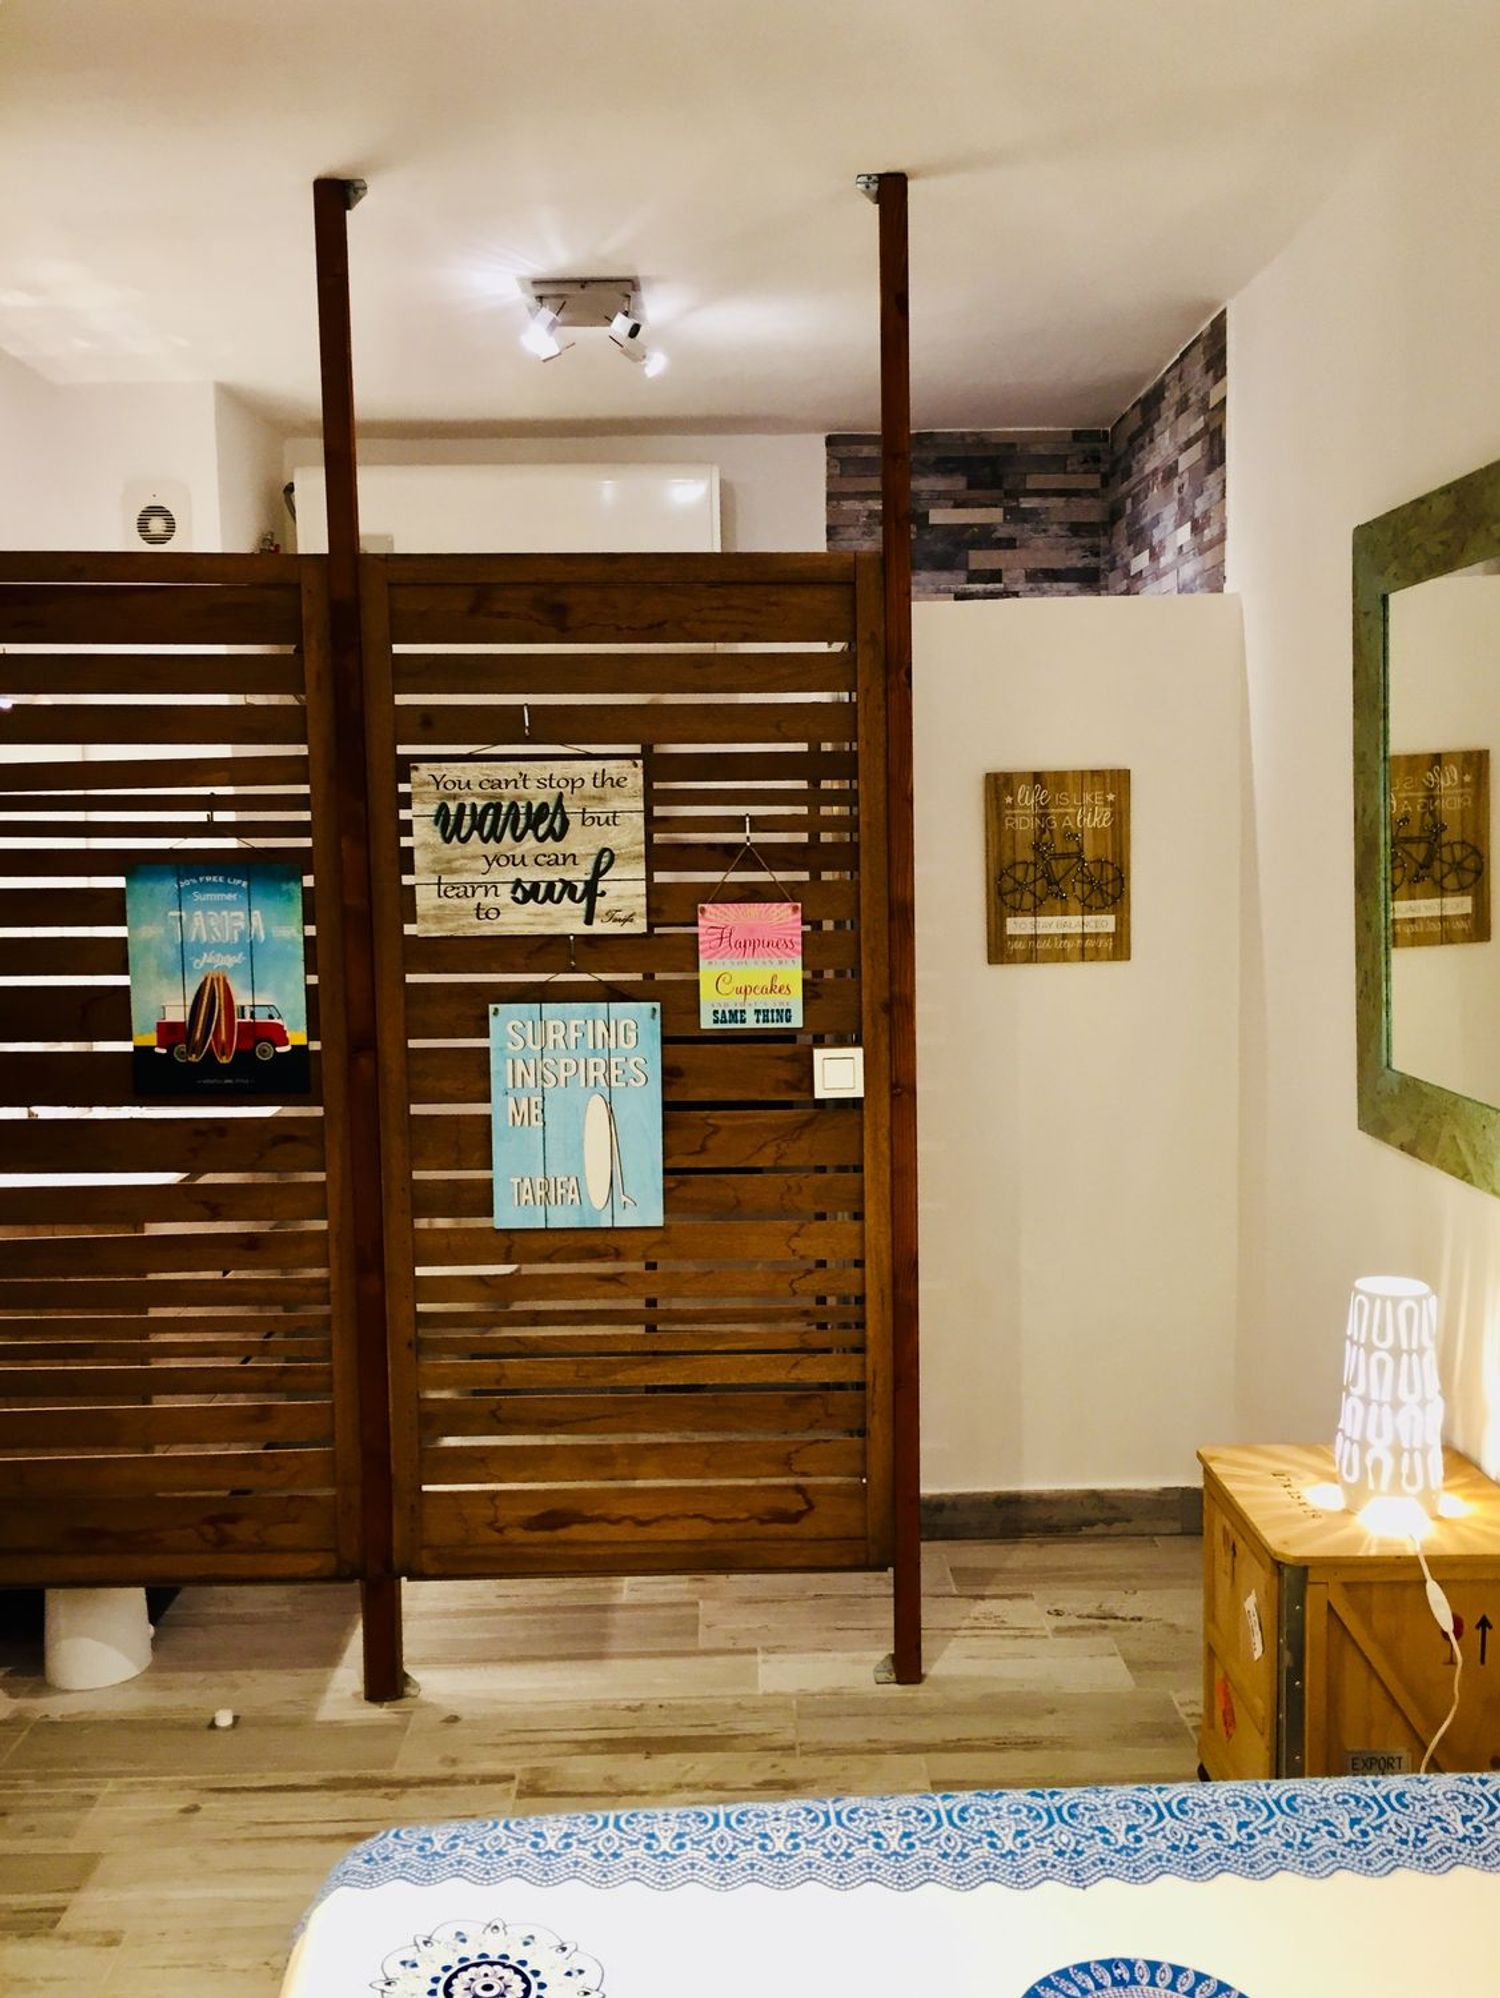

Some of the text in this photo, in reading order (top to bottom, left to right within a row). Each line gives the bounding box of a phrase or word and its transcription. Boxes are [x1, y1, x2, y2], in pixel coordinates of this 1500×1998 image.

[428, 768, 628, 795] You can't stop the
[1016, 784, 1105, 813] life IS LIKE
[433, 792, 620, 844] waves but
[1005, 808, 1115, 830] RIDING A bike
[481, 852, 579, 874] you can
[192, 890, 237, 901] Summer
[199, 875, 224, 883] FREE
[227, 877, 248, 888] LIFE
[437, 847, 615, 926] learn surf
[167, 909, 266, 944] TARIFA
[474, 902, 501, 921] to
[706, 925, 796, 958] Happiness
[715, 971, 792, 1003] Cupcakes
[712, 1008, 792, 1024] SAME THING
[506, 1018, 639, 1051] SURFING
[506, 1057, 649, 1089] INSPIRES
[508, 1095, 545, 1127] ME
[510, 1176, 582, 1207] TARIFA
[1351, 1756, 1402, 1771] EXPORT
